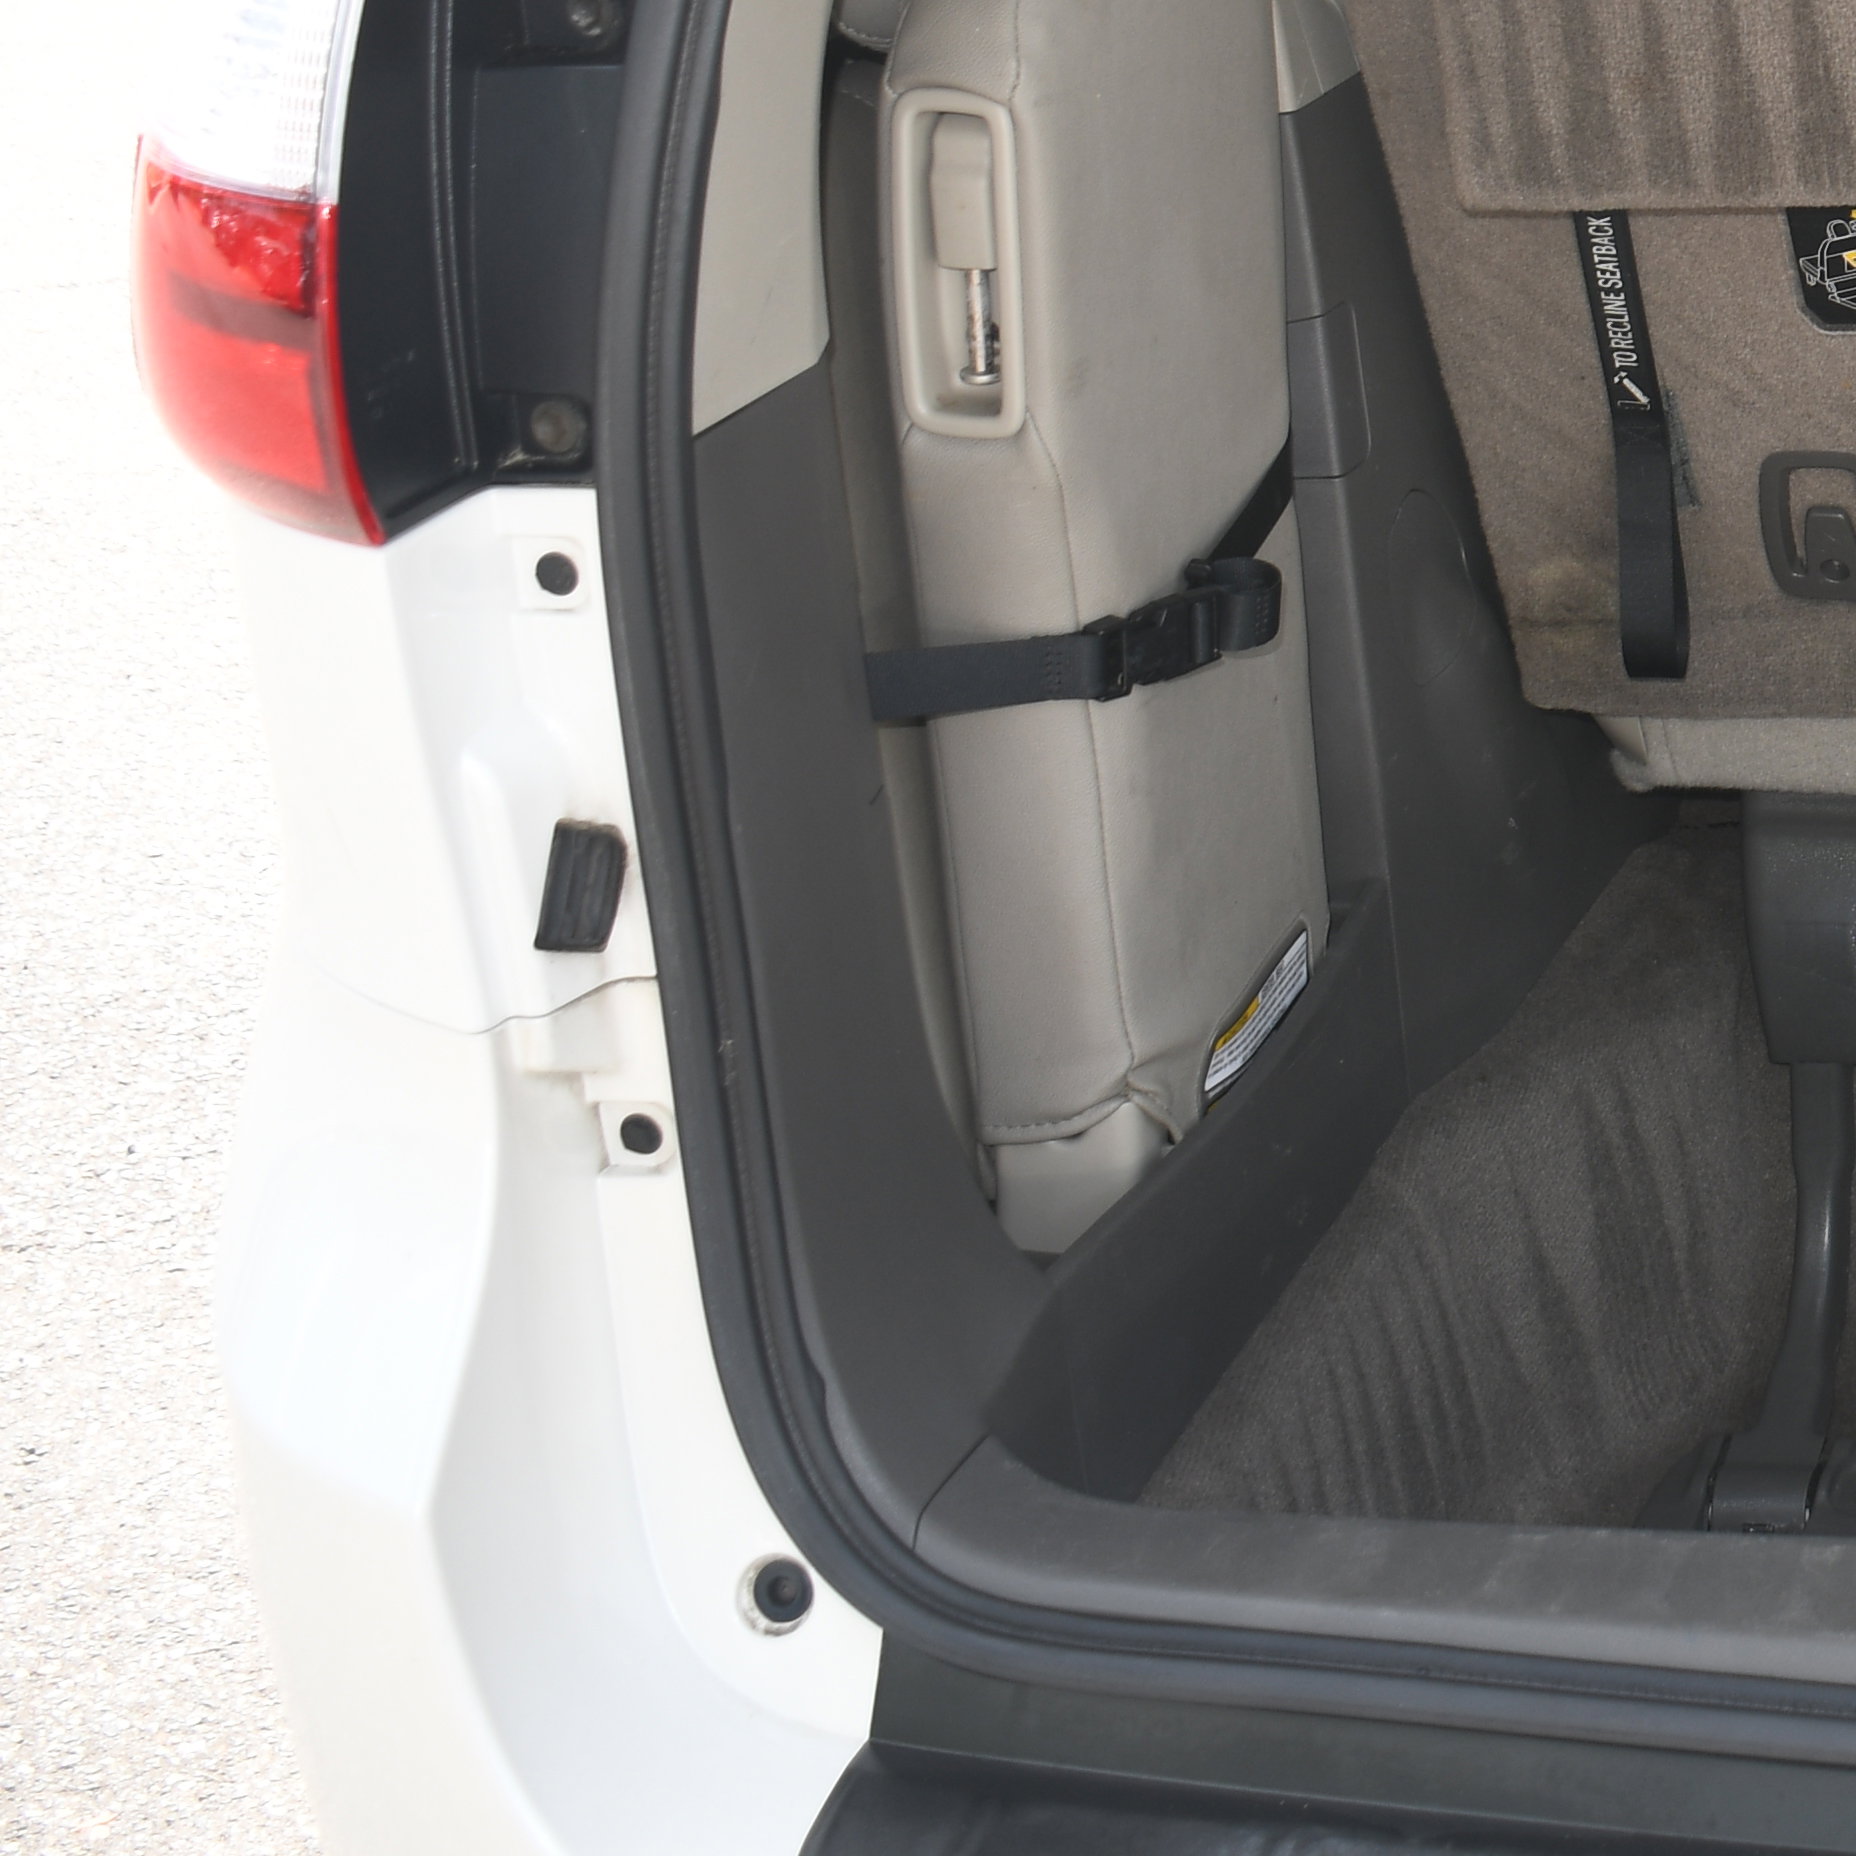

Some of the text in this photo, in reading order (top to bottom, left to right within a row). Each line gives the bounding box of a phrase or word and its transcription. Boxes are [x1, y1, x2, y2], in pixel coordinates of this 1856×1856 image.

[1586, 216, 1639, 368] TO RECLINE SEATBACK
